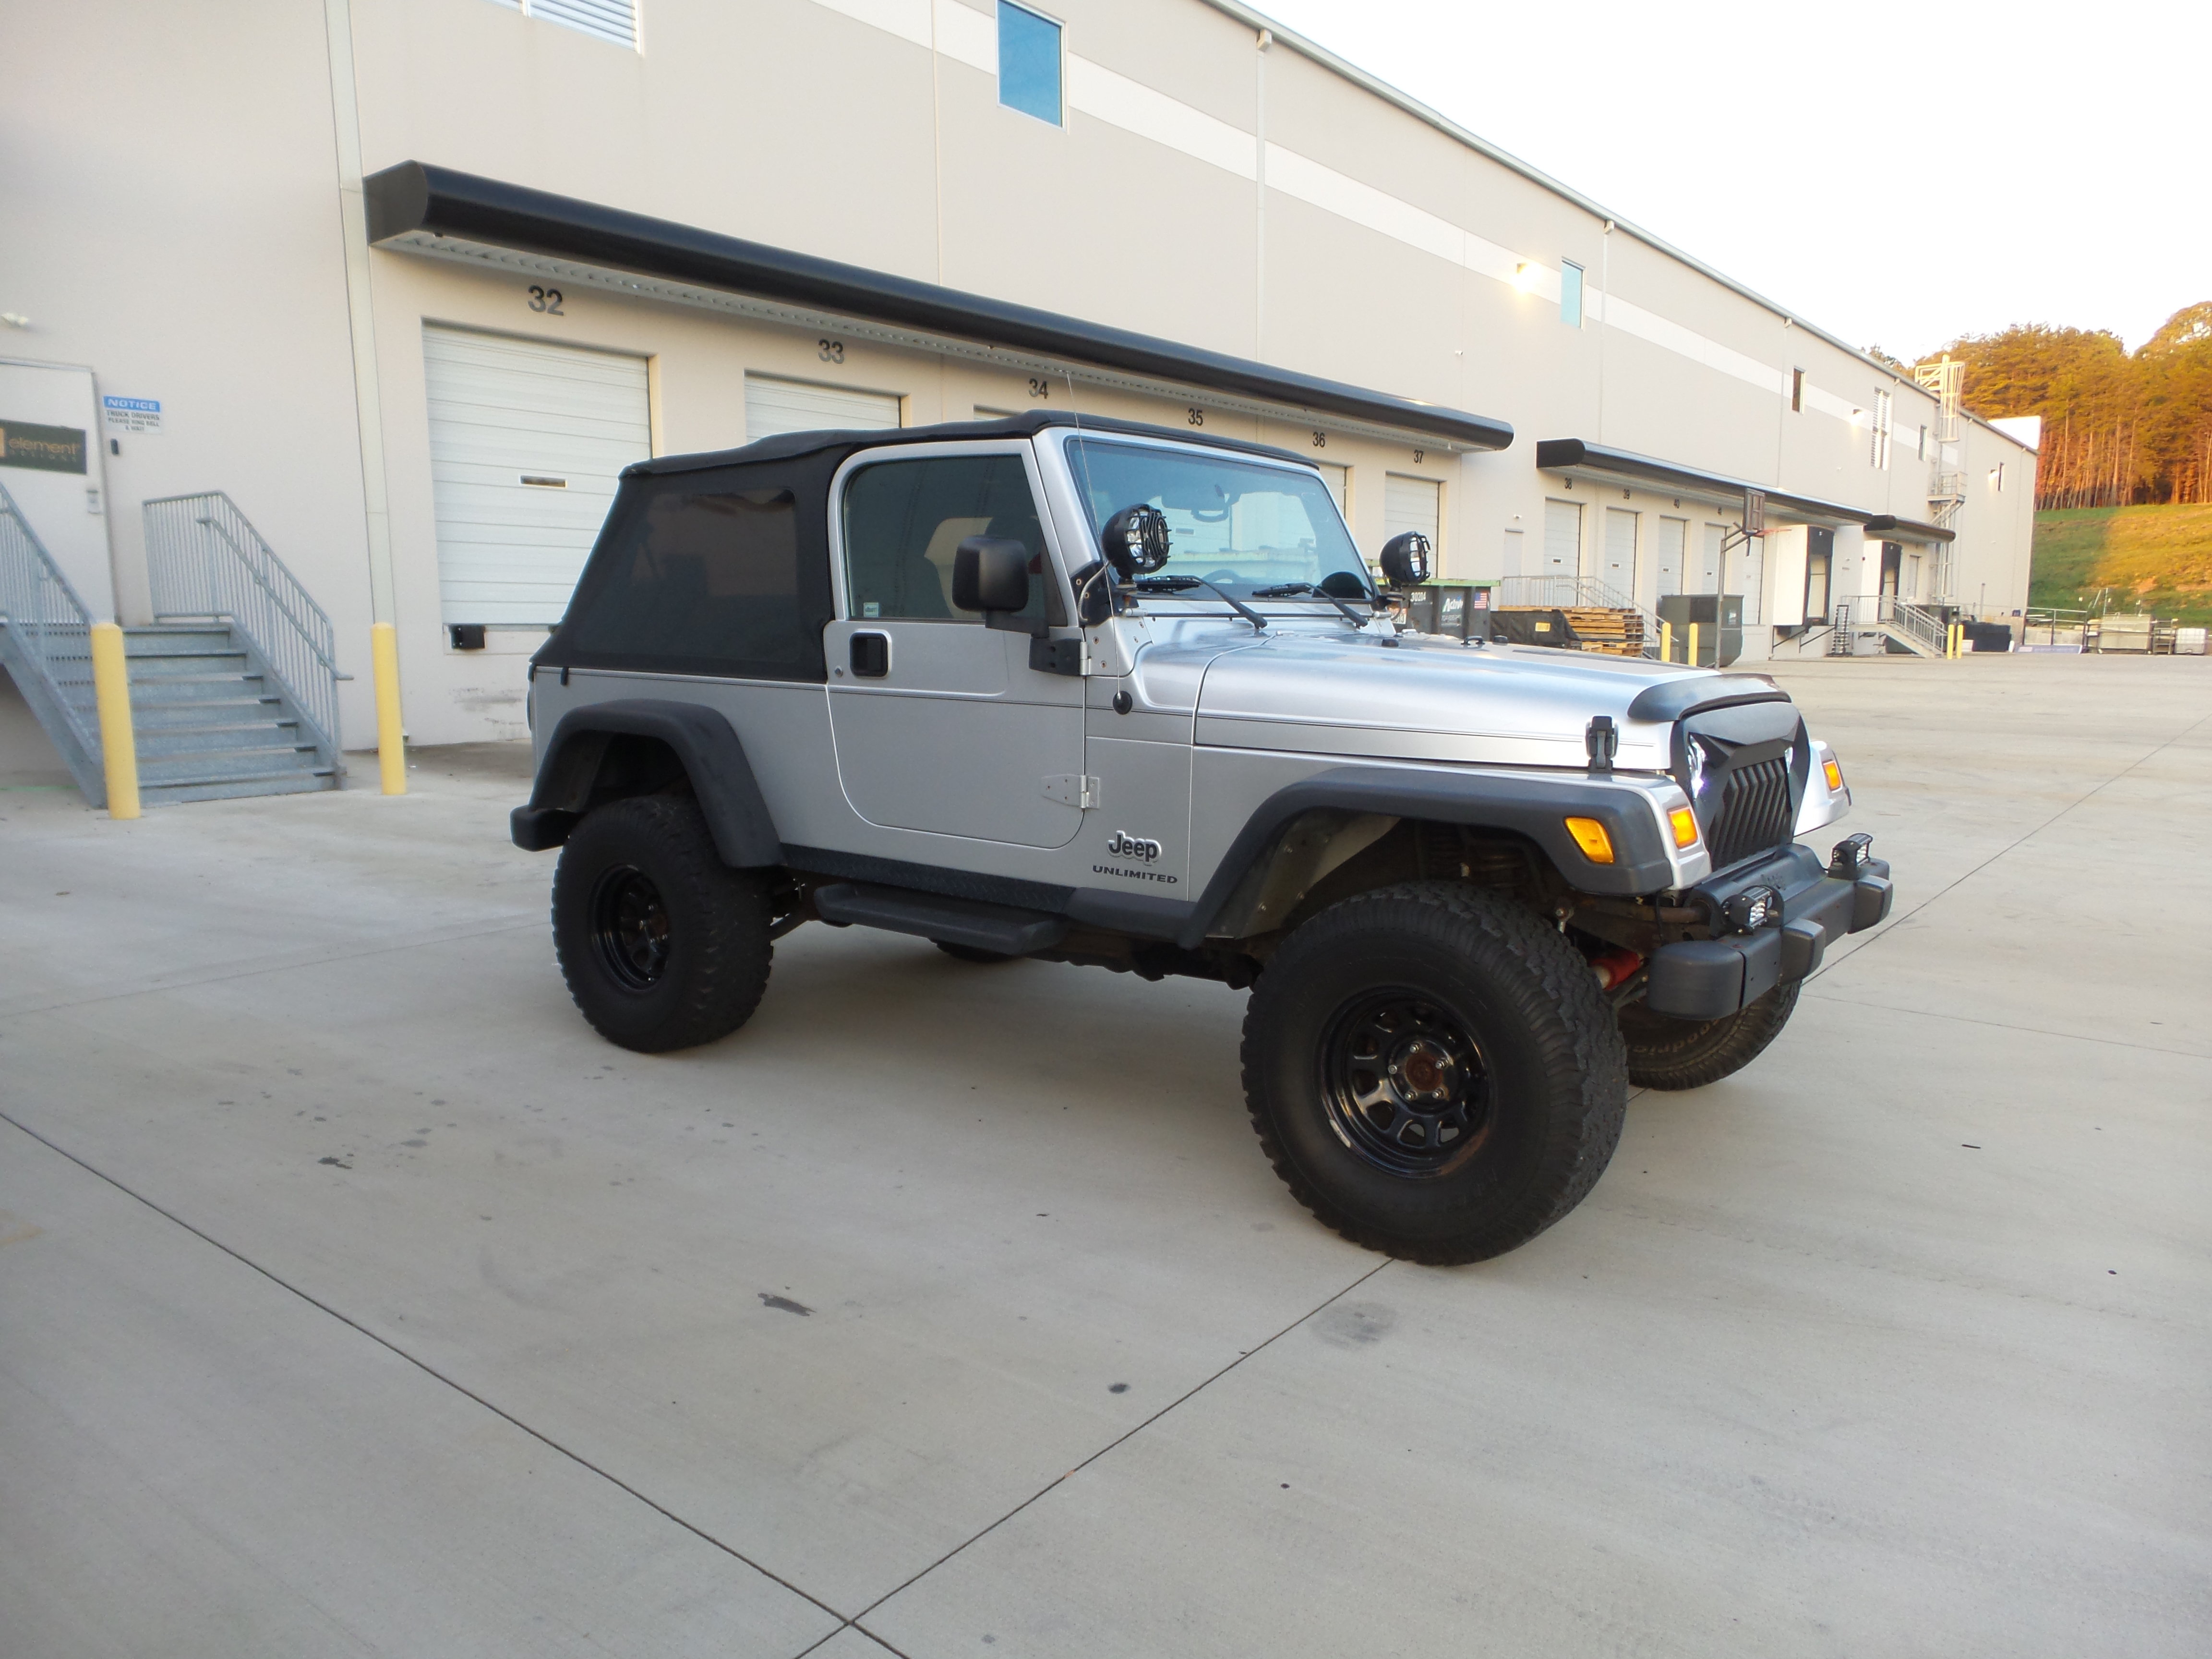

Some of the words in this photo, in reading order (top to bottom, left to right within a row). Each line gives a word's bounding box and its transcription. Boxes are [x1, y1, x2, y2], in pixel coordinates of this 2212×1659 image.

[528, 285, 564, 316] 32
[818, 338, 845, 364] 33
[1028, 378, 1049, 399] 34
[108, 398, 157, 410] NOTICE
[107, 409, 129, 418] TRUCK
[132, 412, 160, 421] DRIVERS
[1188, 408, 1203, 426] 35
[8, 436, 78, 455] element
[1312, 432, 1325, 448] 36
[1413, 449, 1424, 464] 37
[1564, 477, 1572, 490] 38
[1623, 488, 1630, 500] 39
[1108, 831, 1160, 864] Jeep
[1093, 865, 1178, 883] UNLIMITED
